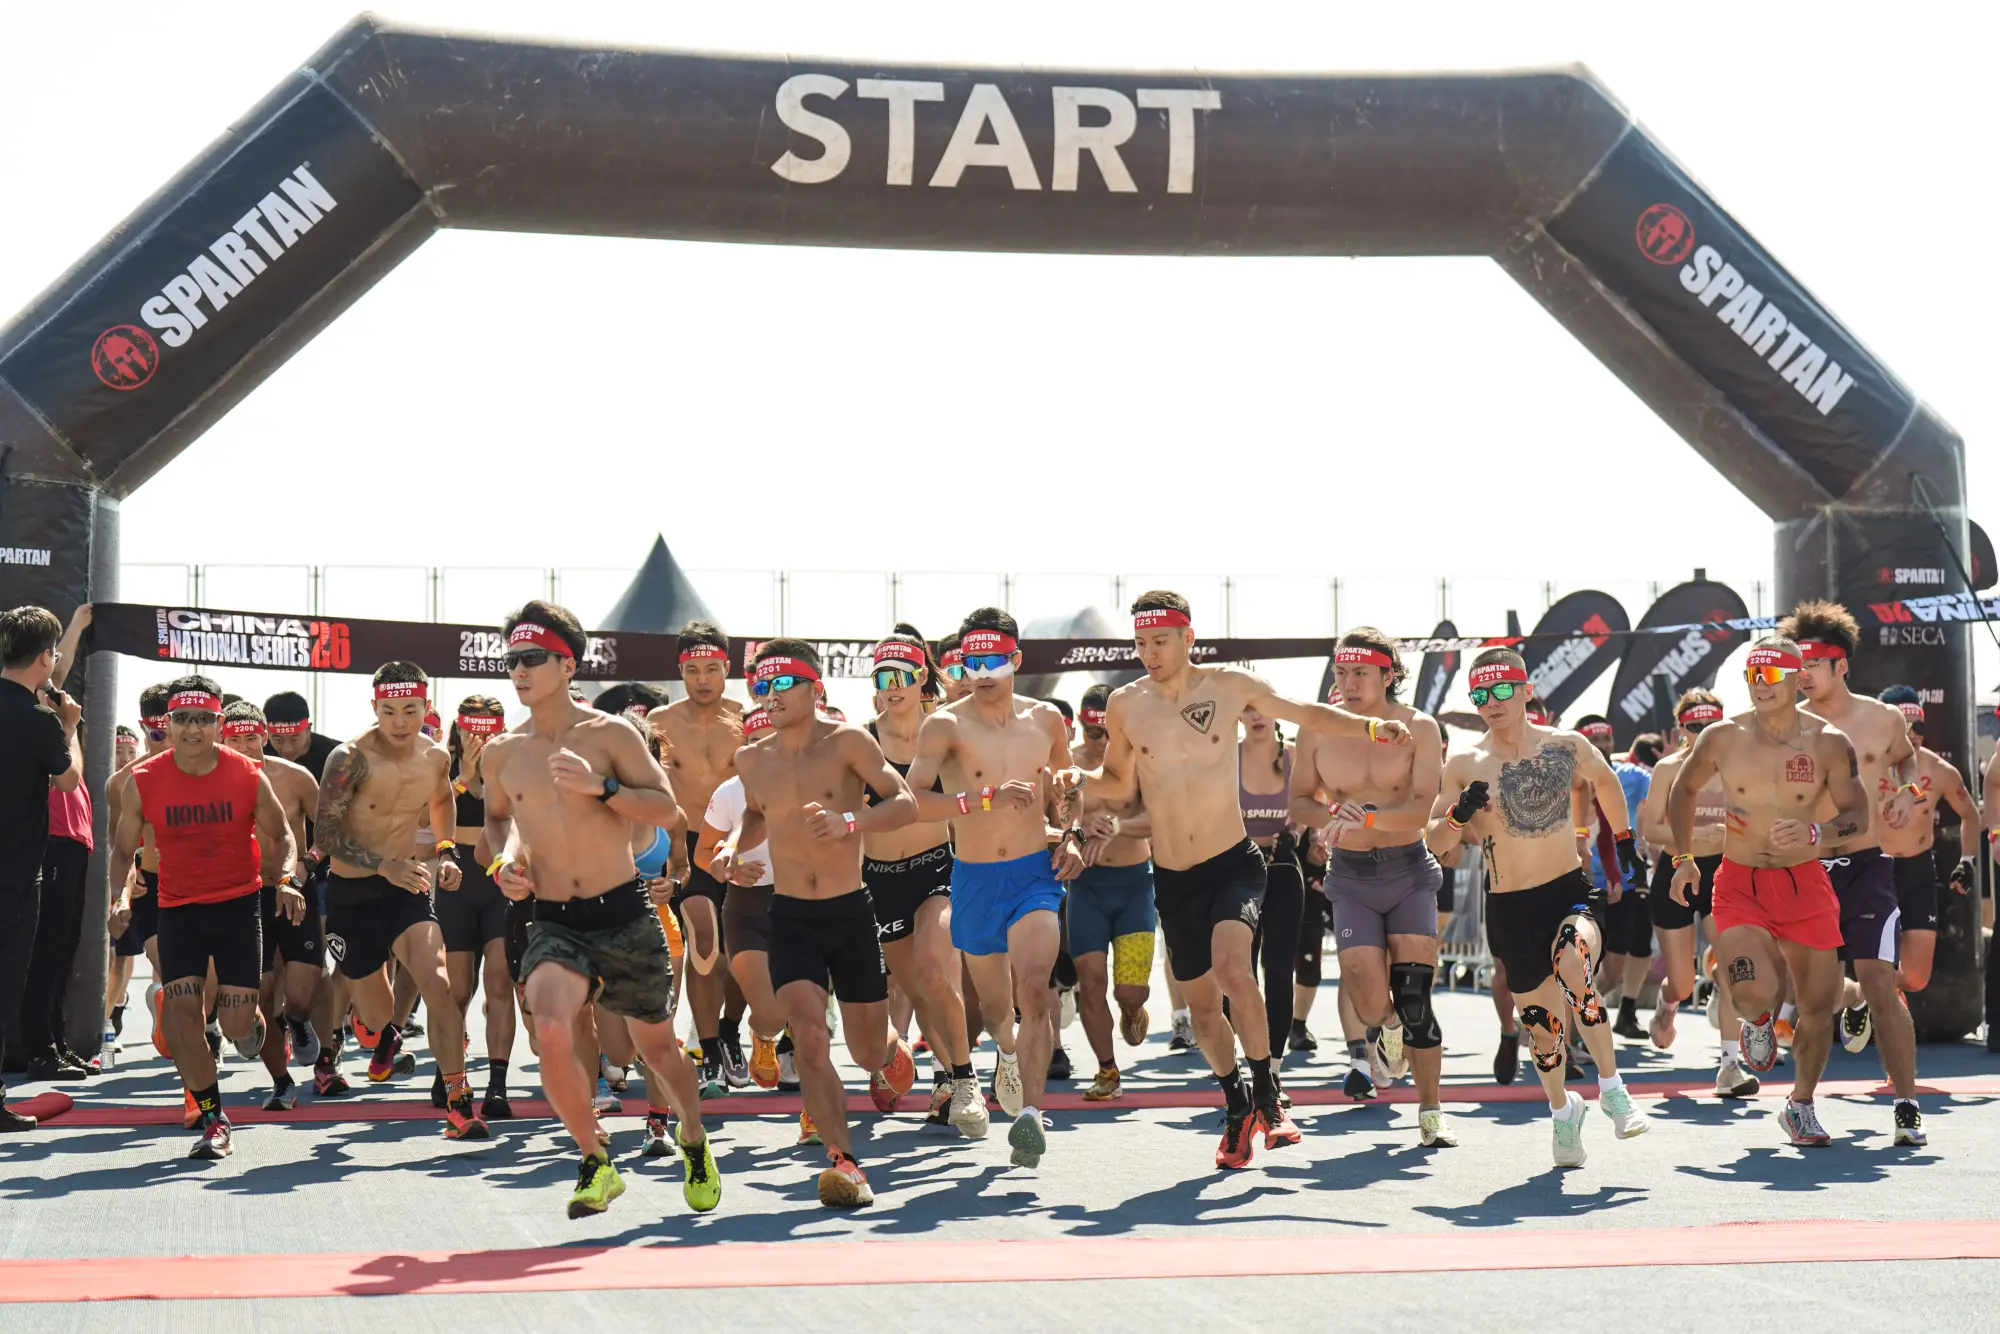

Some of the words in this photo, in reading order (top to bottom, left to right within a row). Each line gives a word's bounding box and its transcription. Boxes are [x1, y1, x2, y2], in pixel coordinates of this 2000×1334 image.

[771, 74, 1222, 193] START
[140, 165, 338, 348] SPARTAN
[1679, 244, 1853, 416] SPARTAN
[0, 547, 51, 566] PARTAN
[1911, 601, 2000, 622] HINA
[157, 608, 169, 645] SPARTAN
[168, 610, 309, 637] CHINA
[969, 634, 1000, 642] SPARTAN
[1901, 626, 1946, 646] SECA
[169, 630, 249, 664] NATIONAL
[251, 633, 310, 668] SERIES
[310, 621, 350, 669] 26
[883, 645, 911, 653] SPARTAN
[970, 642, 993, 650] 2209
[1340, 647, 1372, 656] SPARTAN
[1750, 650, 1781, 658] SPARTAN
[459, 659, 510, 673] SEASO
[758, 657, 791, 668] SPARTAN
[1478, 665, 1510, 674] SPARTAN
[759, 665, 780, 676] 2201
[1479, 672, 1502, 682] 2218
[386, 682, 417, 690] SPARTAN
[388, 689, 412, 697] 2270
[180, 690, 210, 699] SPARTAN
[751, 712, 767, 721] SPAR
[166, 801, 232, 827] HOOAH
[1695, 807, 1726, 817] SPART
[867, 862, 907, 873] NIKE
[910, 849, 945, 869] PRO
[879, 919, 904, 935] KE
[164, 982, 200, 999] OOAH
